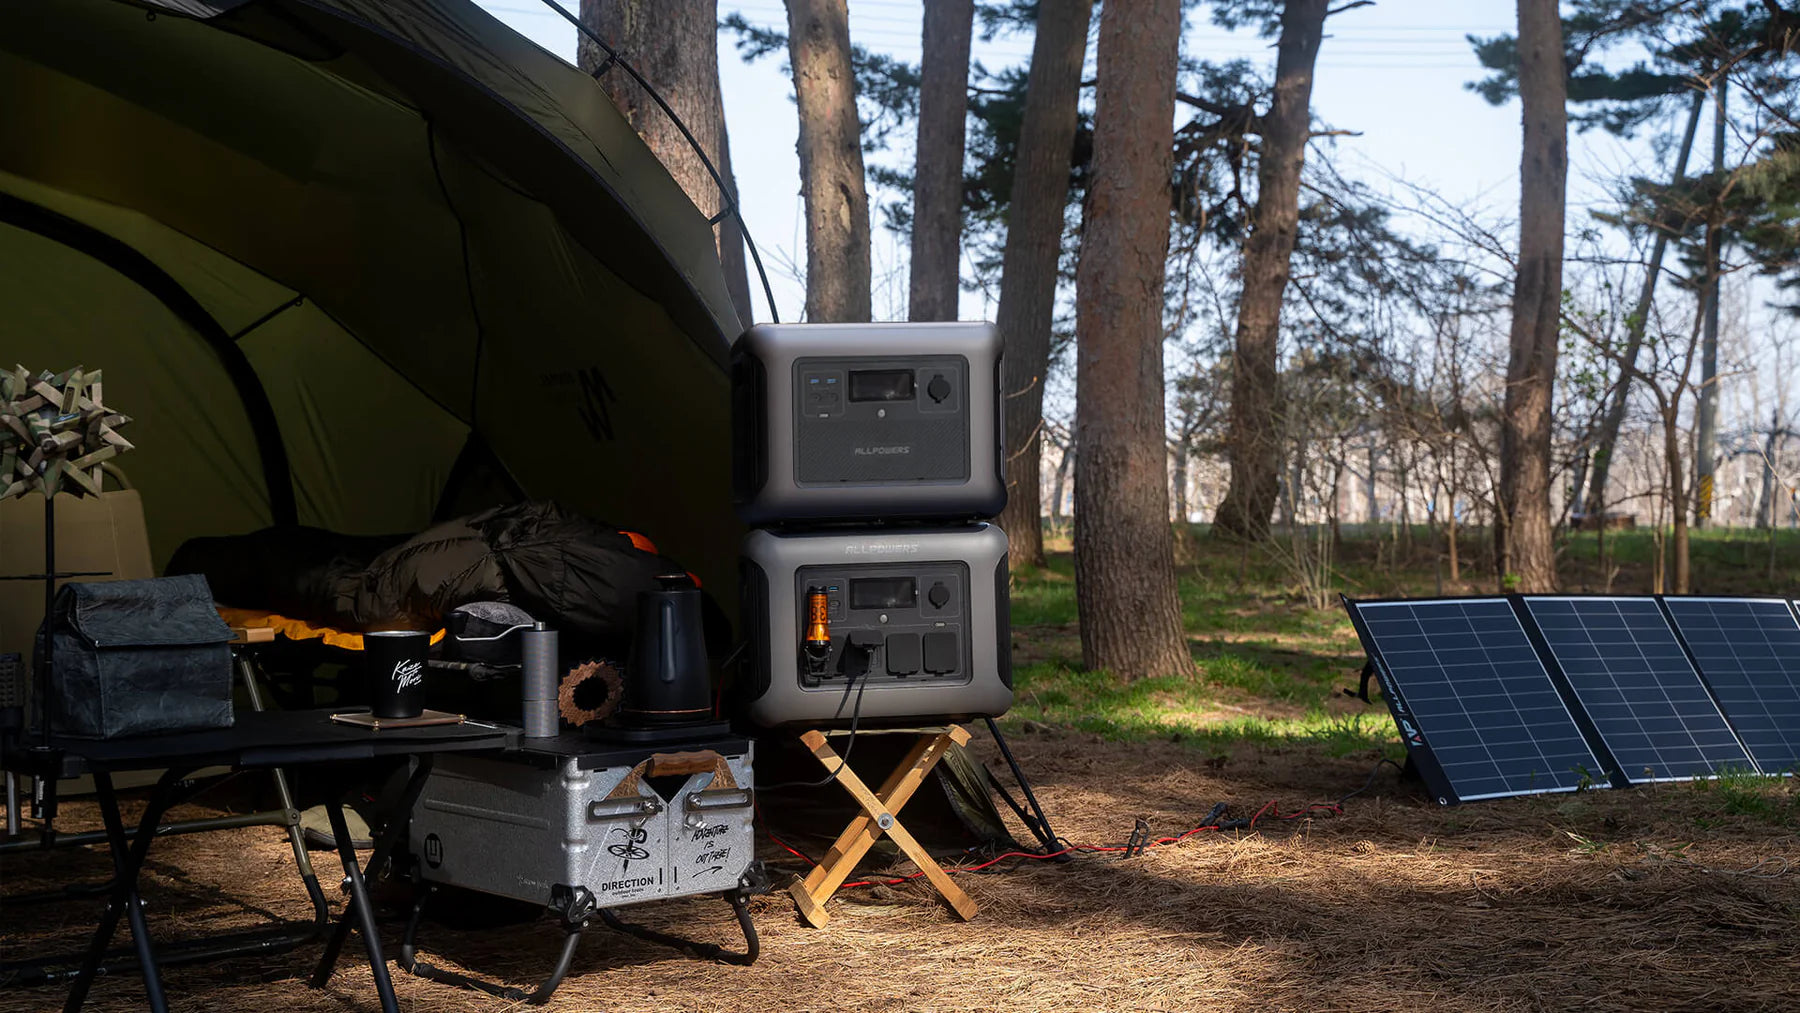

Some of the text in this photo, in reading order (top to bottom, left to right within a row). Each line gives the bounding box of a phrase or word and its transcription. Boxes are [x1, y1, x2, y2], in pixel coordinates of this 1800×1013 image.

[854, 446, 910, 456] ALLPOWERS
[845, 543, 919, 554] ALLPOWERS
[703, 840, 715, 850] IS
[601, 876, 654, 891] DIRECTION
